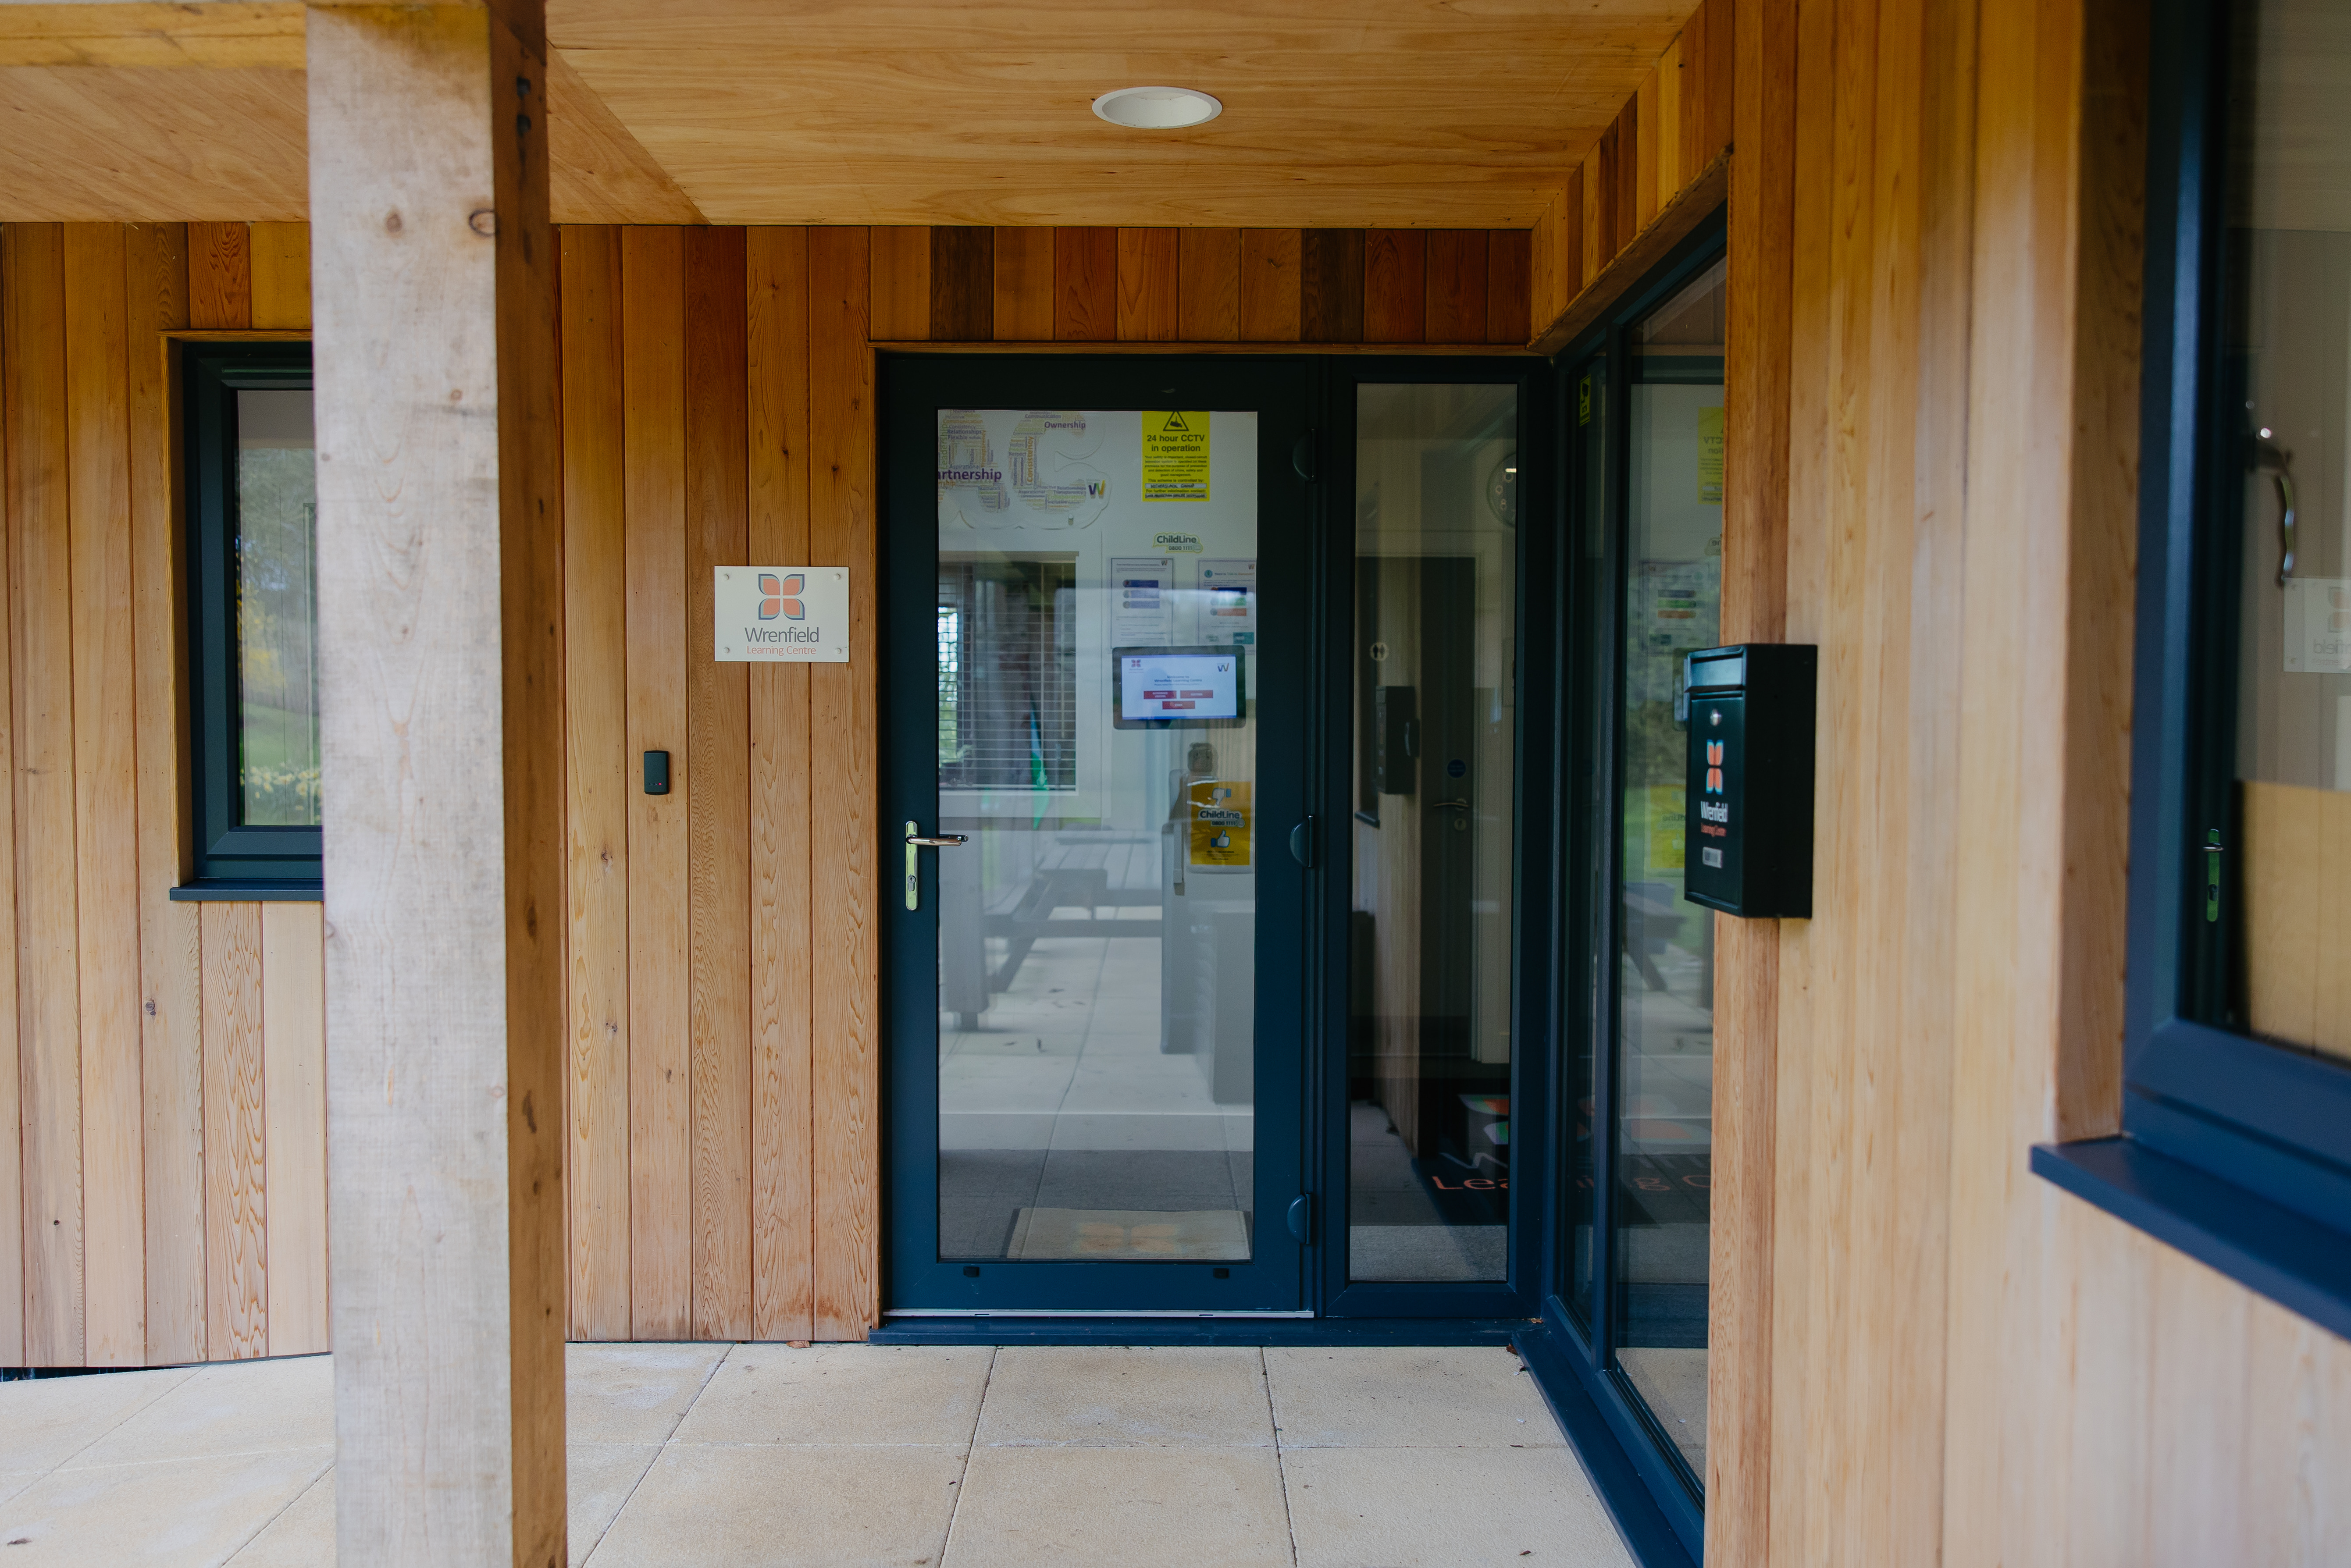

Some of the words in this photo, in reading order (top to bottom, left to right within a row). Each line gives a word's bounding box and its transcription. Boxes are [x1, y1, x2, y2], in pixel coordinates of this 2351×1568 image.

[1044, 421, 1086, 430] Ownership
[1161, 444, 1200, 453] operation
[938, 468, 1002, 482] rtnership
[1157, 535, 1197, 544] ChildLine
[744, 626, 819, 642] Wrenfield
[747, 645, 784, 656] Learning
[787, 646, 816, 654] Centre
[1200, 810, 1240, 818] ChildLine
[1700, 800, 1728, 823] Wrenfield
